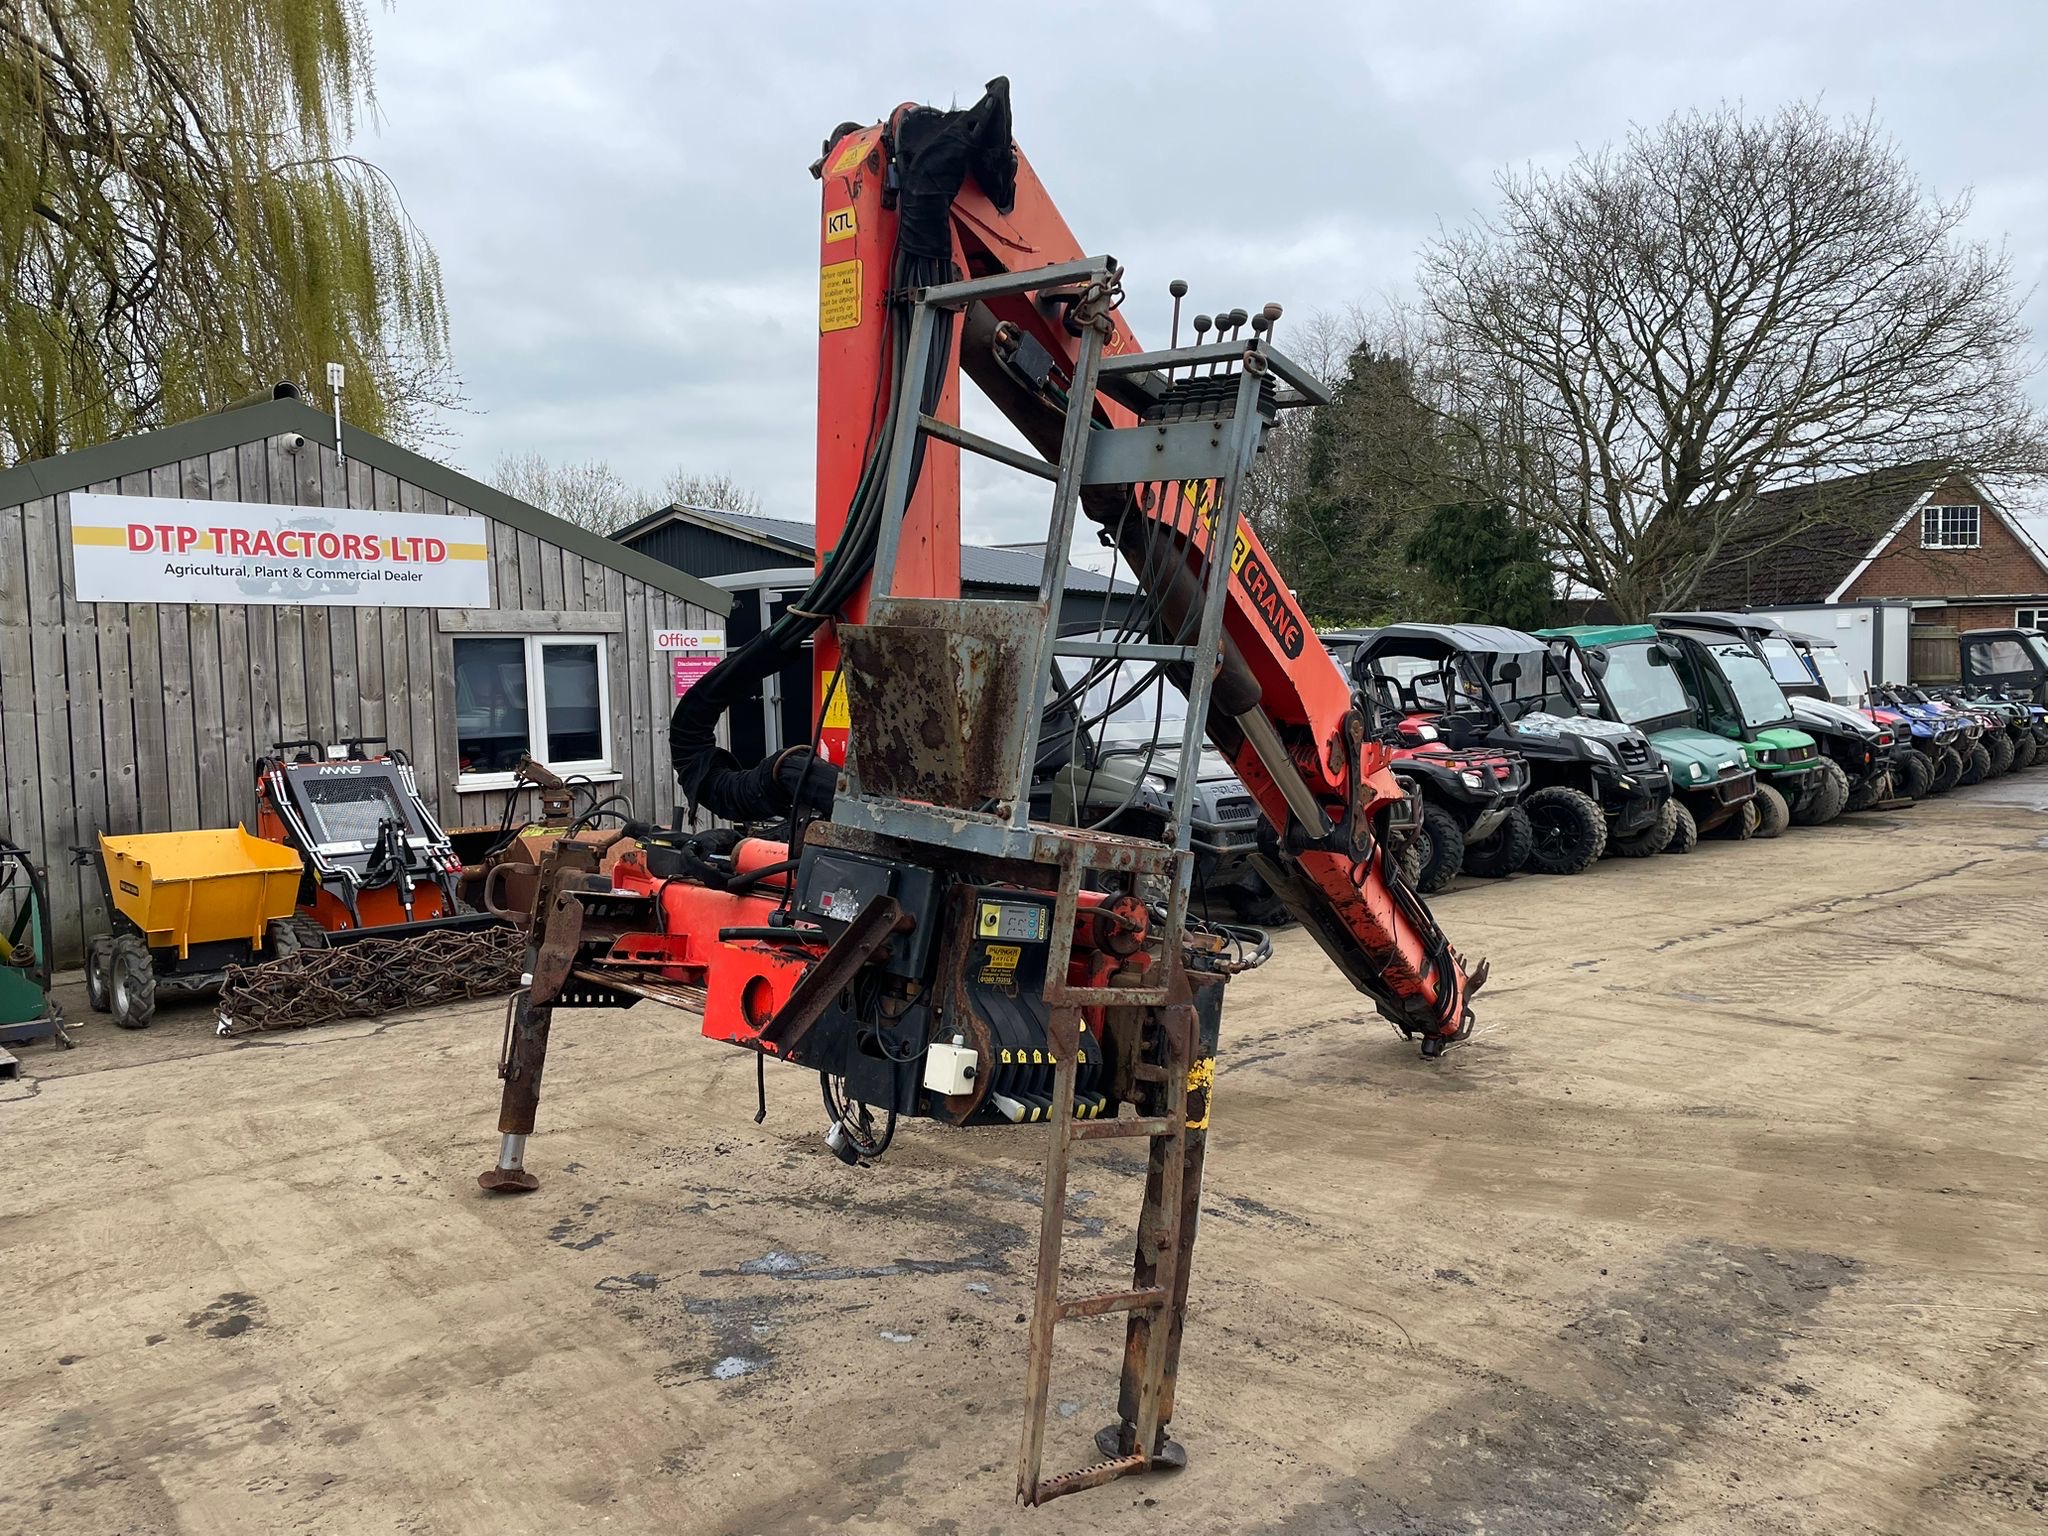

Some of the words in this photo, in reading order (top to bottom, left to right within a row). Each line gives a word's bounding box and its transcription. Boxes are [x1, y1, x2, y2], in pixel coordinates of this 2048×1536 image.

[829, 212, 853, 234] KTL
[842, 277, 852, 286] ALL
[127, 523, 198, 553] DTP
[208, 527, 381, 561] TRACTORS
[391, 536, 447, 563] LTD
[164, 563, 251, 578] Agricultural,
[255, 566, 289, 578] Plant
[292, 567, 302, 578] &
[306, 567, 380, 581] Commercial
[384, 570, 423, 582] Dealer
[1243, 560, 1299, 650] CRANE
[658, 633, 698, 647] Office
